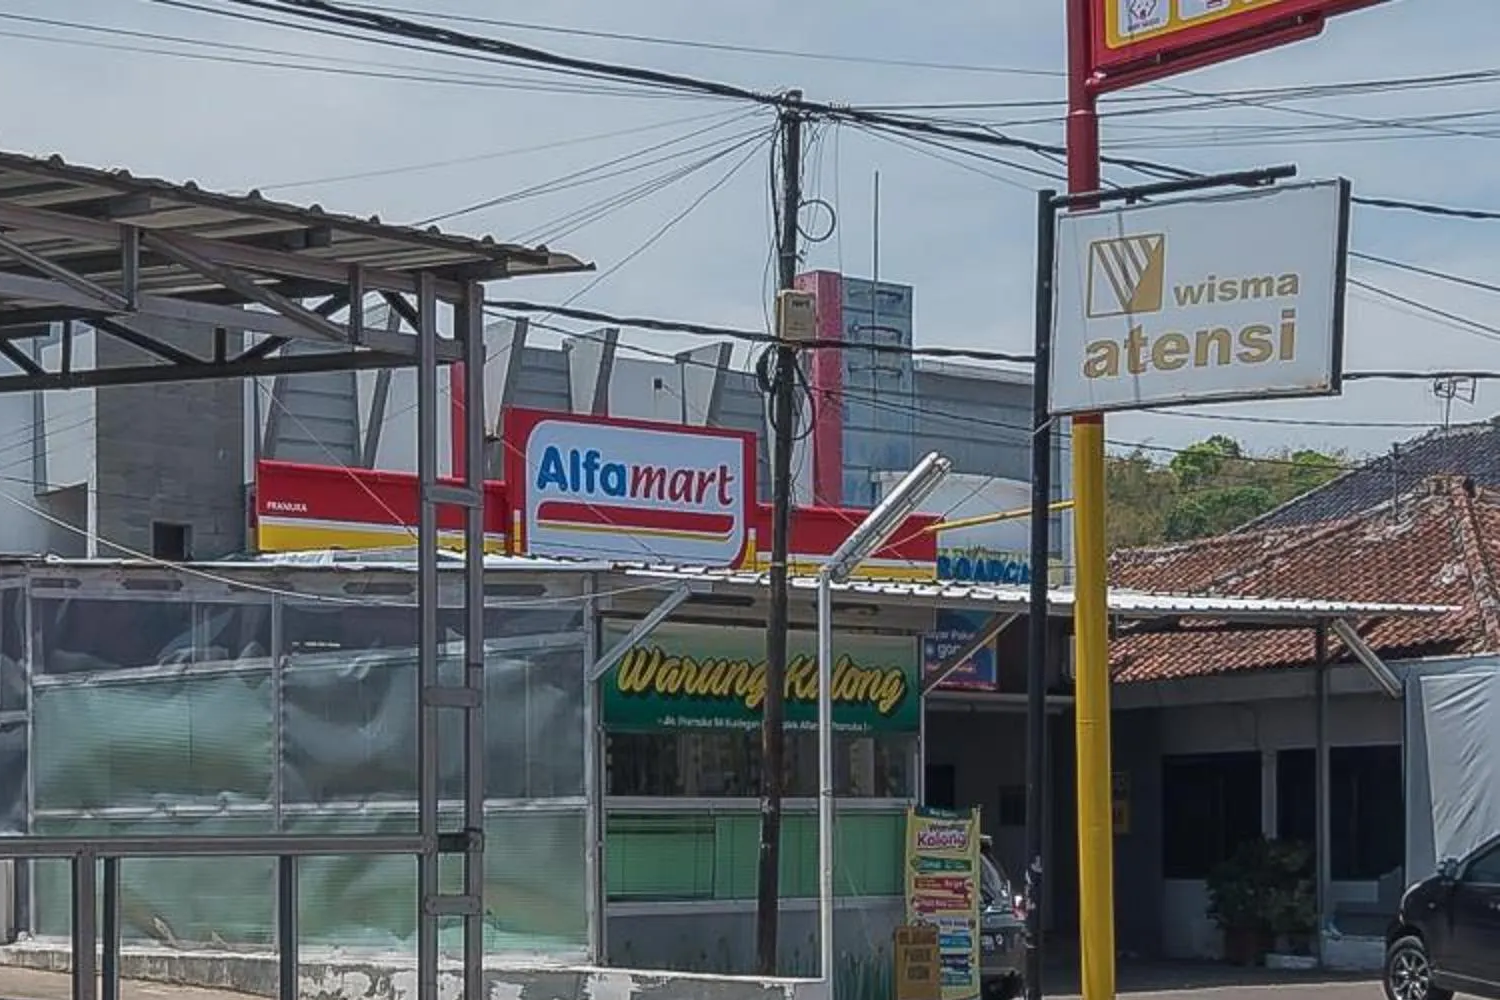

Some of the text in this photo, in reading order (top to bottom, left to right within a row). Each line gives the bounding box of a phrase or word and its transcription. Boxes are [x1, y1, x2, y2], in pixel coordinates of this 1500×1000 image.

[1173, 271, 1300, 307] wisma
[1083, 308, 1297, 380] atensi
[536, 445, 735, 506] Alfamart
[617, 645, 768, 709] Warung
